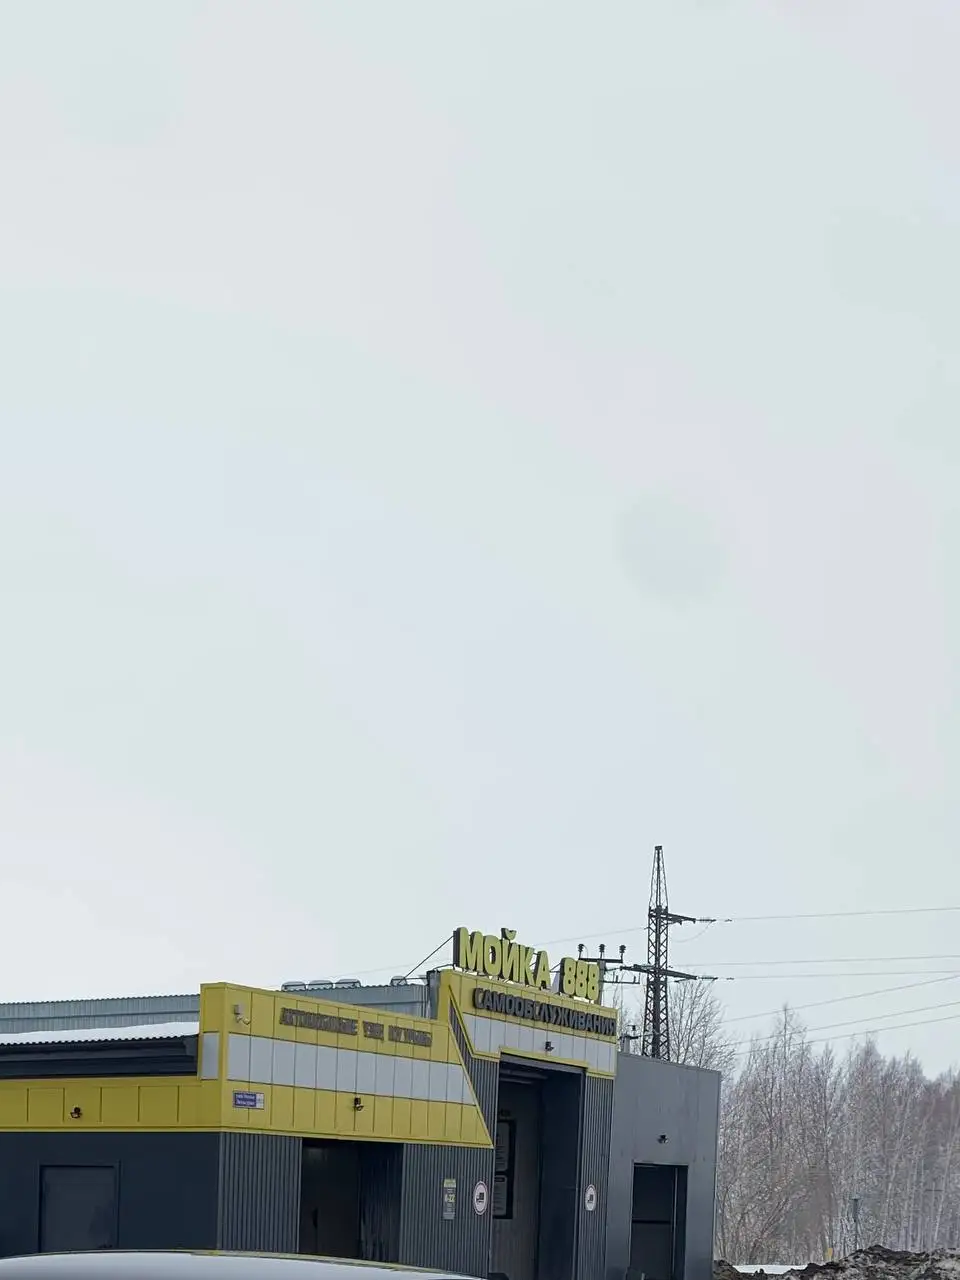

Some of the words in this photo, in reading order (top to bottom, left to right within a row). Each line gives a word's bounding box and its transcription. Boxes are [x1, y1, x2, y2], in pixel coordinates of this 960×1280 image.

[453, 927, 551, 988] МОЙКА
[559, 957, 600, 1001] 888
[474, 987, 617, 1036] САМООБСЛУЖИВАНИЯ
